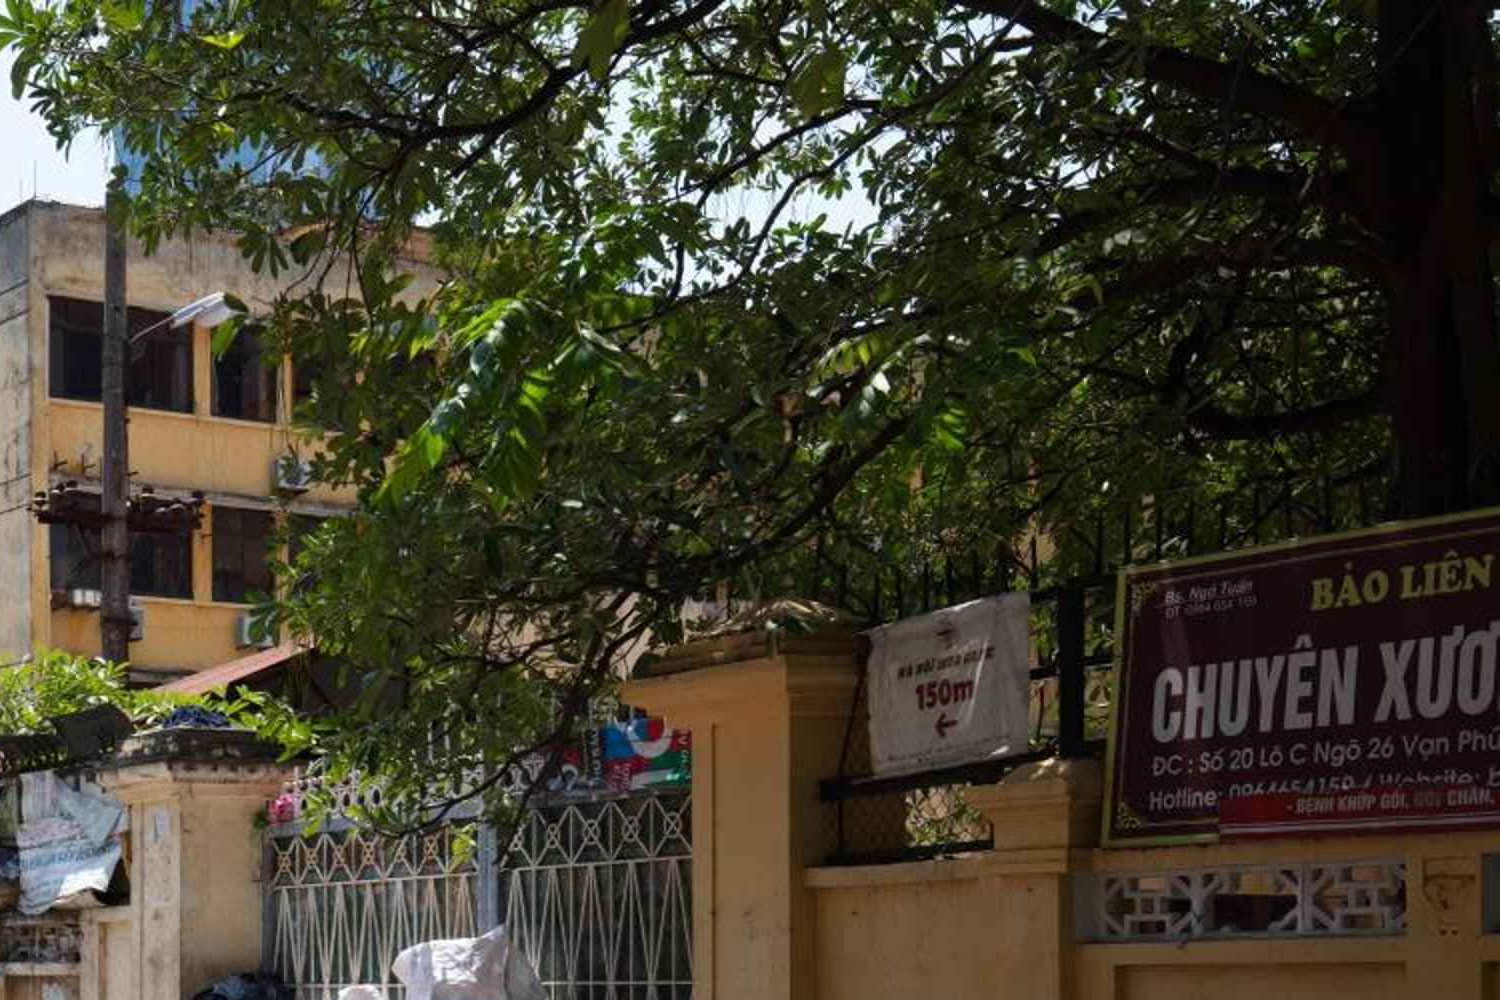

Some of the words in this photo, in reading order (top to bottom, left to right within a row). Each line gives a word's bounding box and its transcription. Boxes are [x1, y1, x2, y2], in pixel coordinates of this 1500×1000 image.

[1309, 561, 1389, 611] BẢO
[1399, 549, 1495, 600] LIÊN
[915, 679, 974, 710] 150m
[1152, 634, 1359, 744] CHUYÊN
[1374, 619, 1500, 723] XƯƠ
[1199, 747, 1223, 773] Số
[1230, 749, 1253, 770] 20
[1289, 743, 1307, 765] C
[1314, 738, 1362, 767] Ngõ
[1368, 736, 1395, 759] 26
[1402, 733, 1449, 761] Vạn
[1150, 788, 1223, 811] Hotline:
